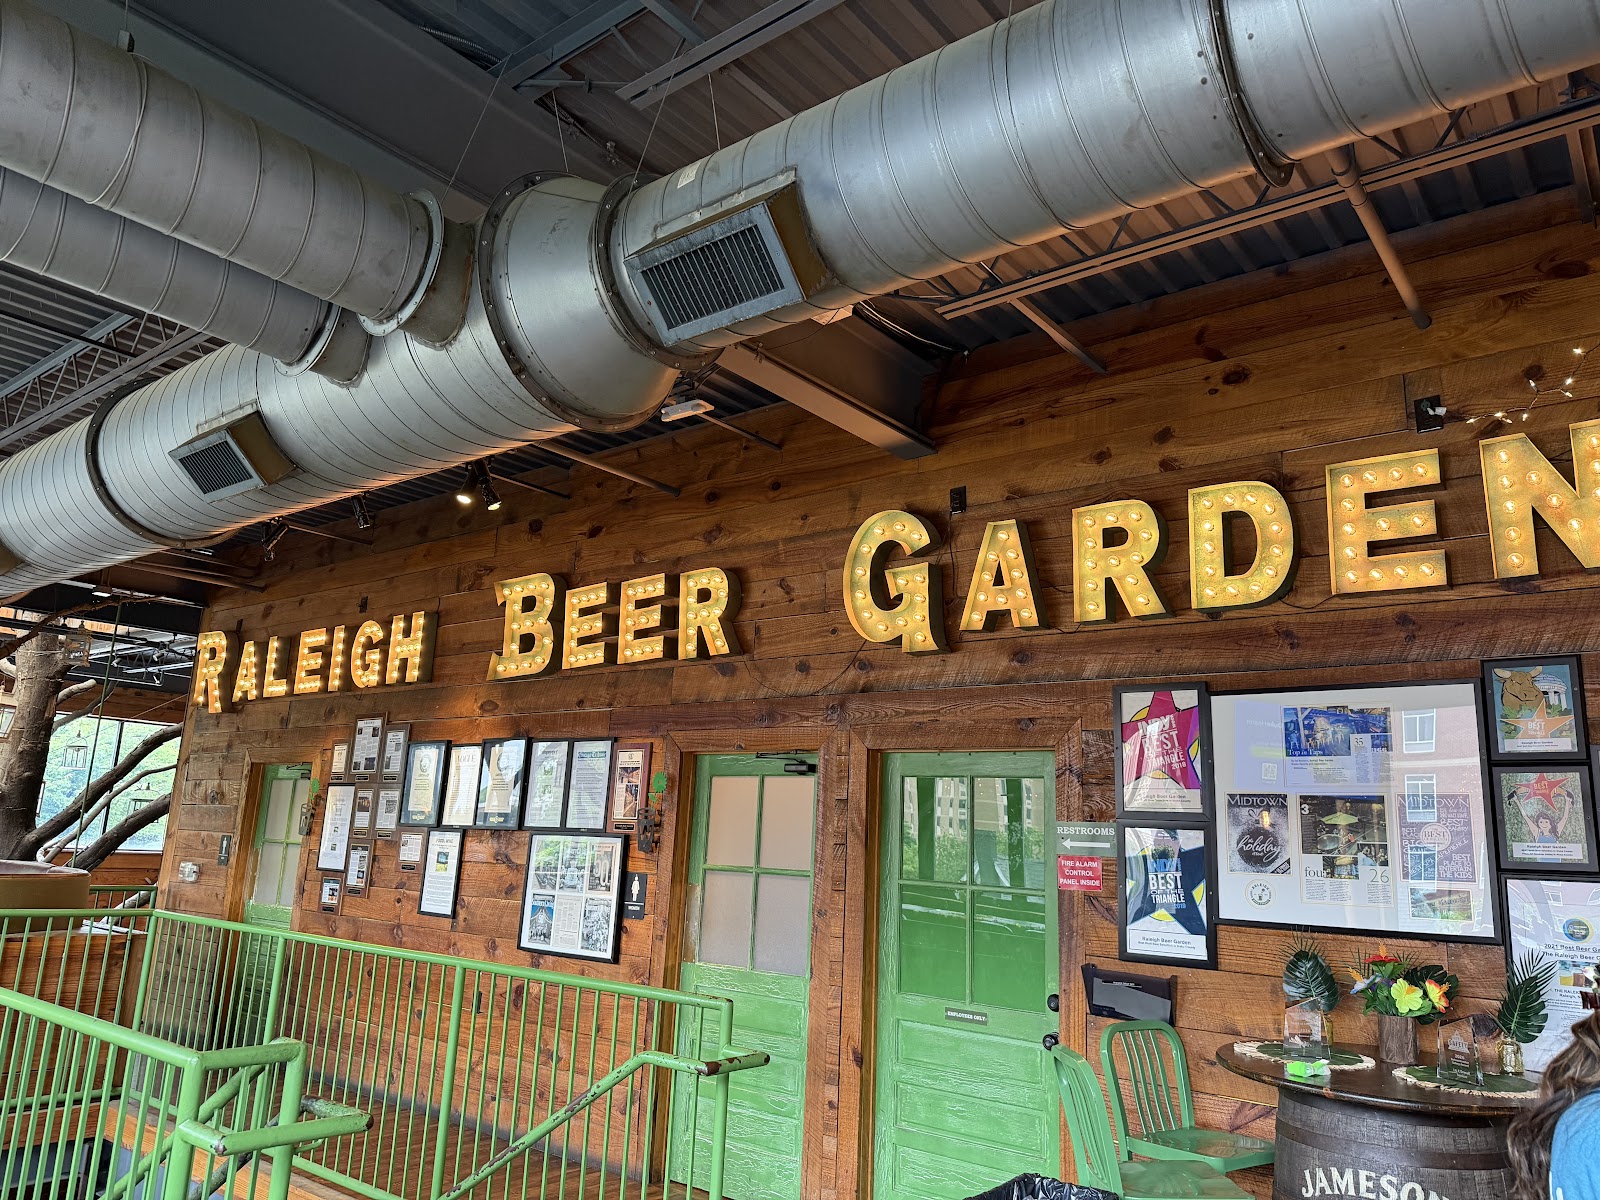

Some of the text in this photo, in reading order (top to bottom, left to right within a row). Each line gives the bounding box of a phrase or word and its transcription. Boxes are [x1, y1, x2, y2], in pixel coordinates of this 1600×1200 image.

[194, 418, 1600, 714] RALEIGH BEER GARDEN
[1528, 721, 1545, 730] BEST
[1142, 731, 1179, 752] BEST
[1147, 752, 1185, 767] TRIANGLE
[1227, 794, 1288, 806] MIDTOWN
[1301, 804, 1310, 814] 3
[1056, 826, 1115, 836] RESTROOMS
[1424, 830, 1445, 838] BEST
[1236, 834, 1281, 862] holiday
[1452, 853, 1471, 861] BEST
[1065, 869, 1095, 877] CONTROL
[1368, 868, 1390, 884] 26
[1454, 871, 1473, 879] KIDS
[1080, 879, 1101, 887] INSIDE
[1148, 872, 1183, 890] BEST
[1151, 893, 1186, 904] TRIANGLE
[1555, 952, 1578, 960] Raleigh
